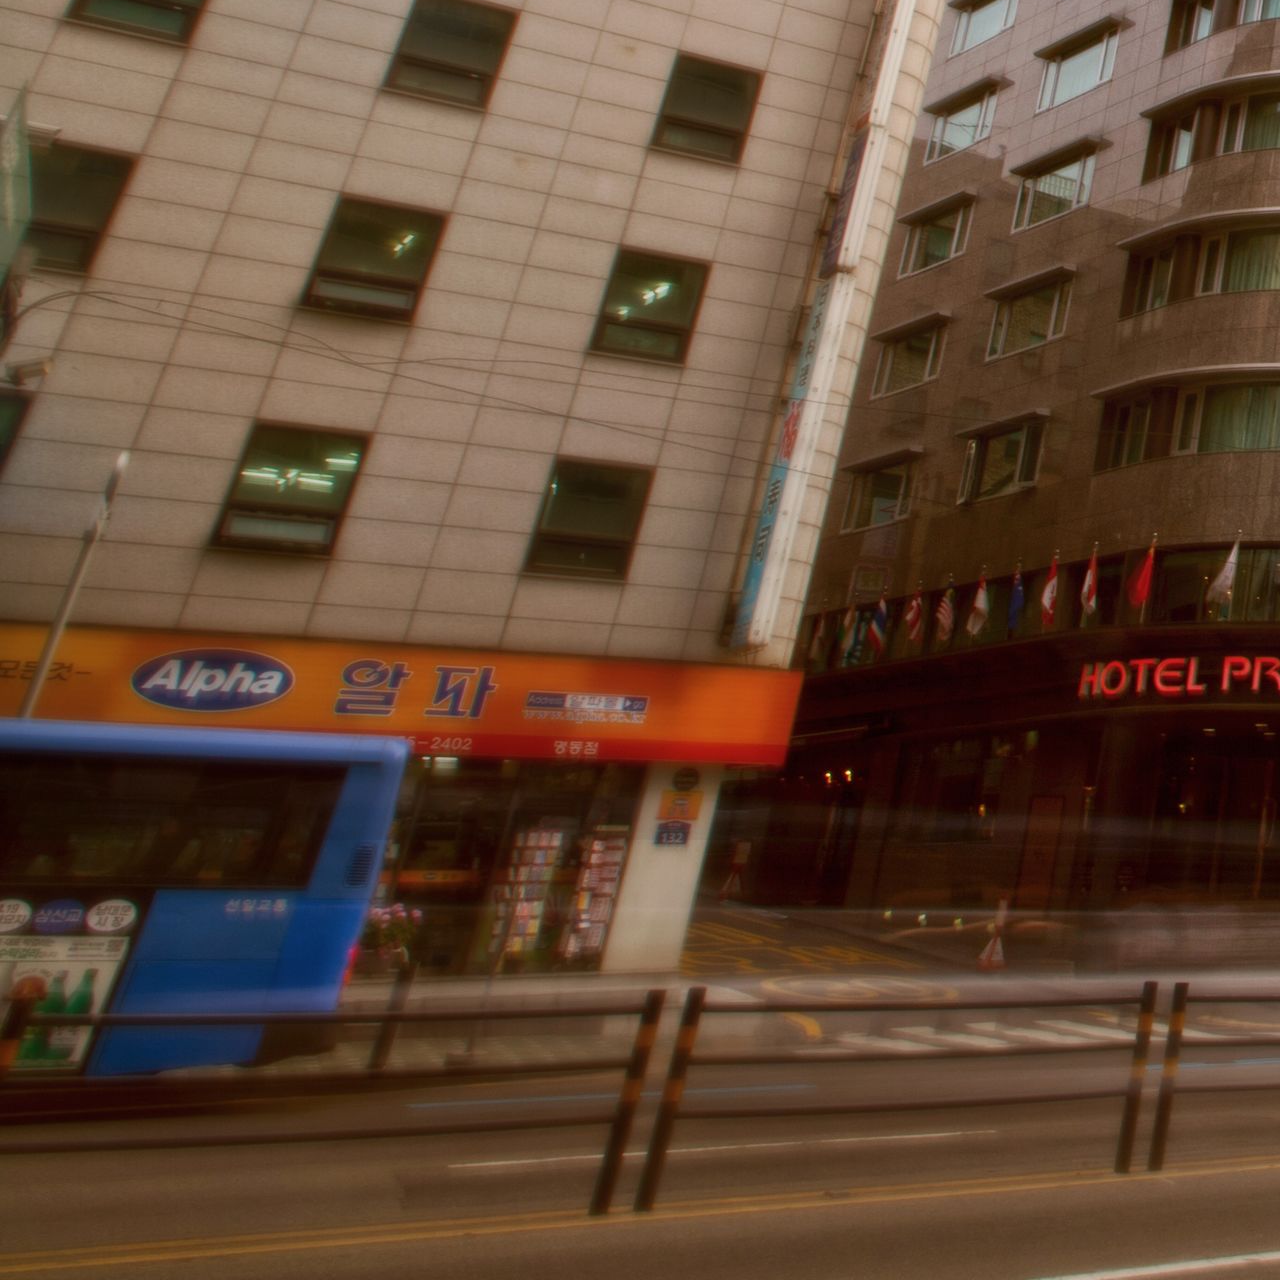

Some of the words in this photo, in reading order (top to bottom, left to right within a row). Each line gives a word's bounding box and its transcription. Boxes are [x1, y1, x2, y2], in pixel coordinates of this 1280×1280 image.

[141, 659, 285, 698] Alpha
[333, 658, 500, 719] 알파
[1077, 656, 1208, 698] HOTEL
[553, 739, 599, 756] 명동점
